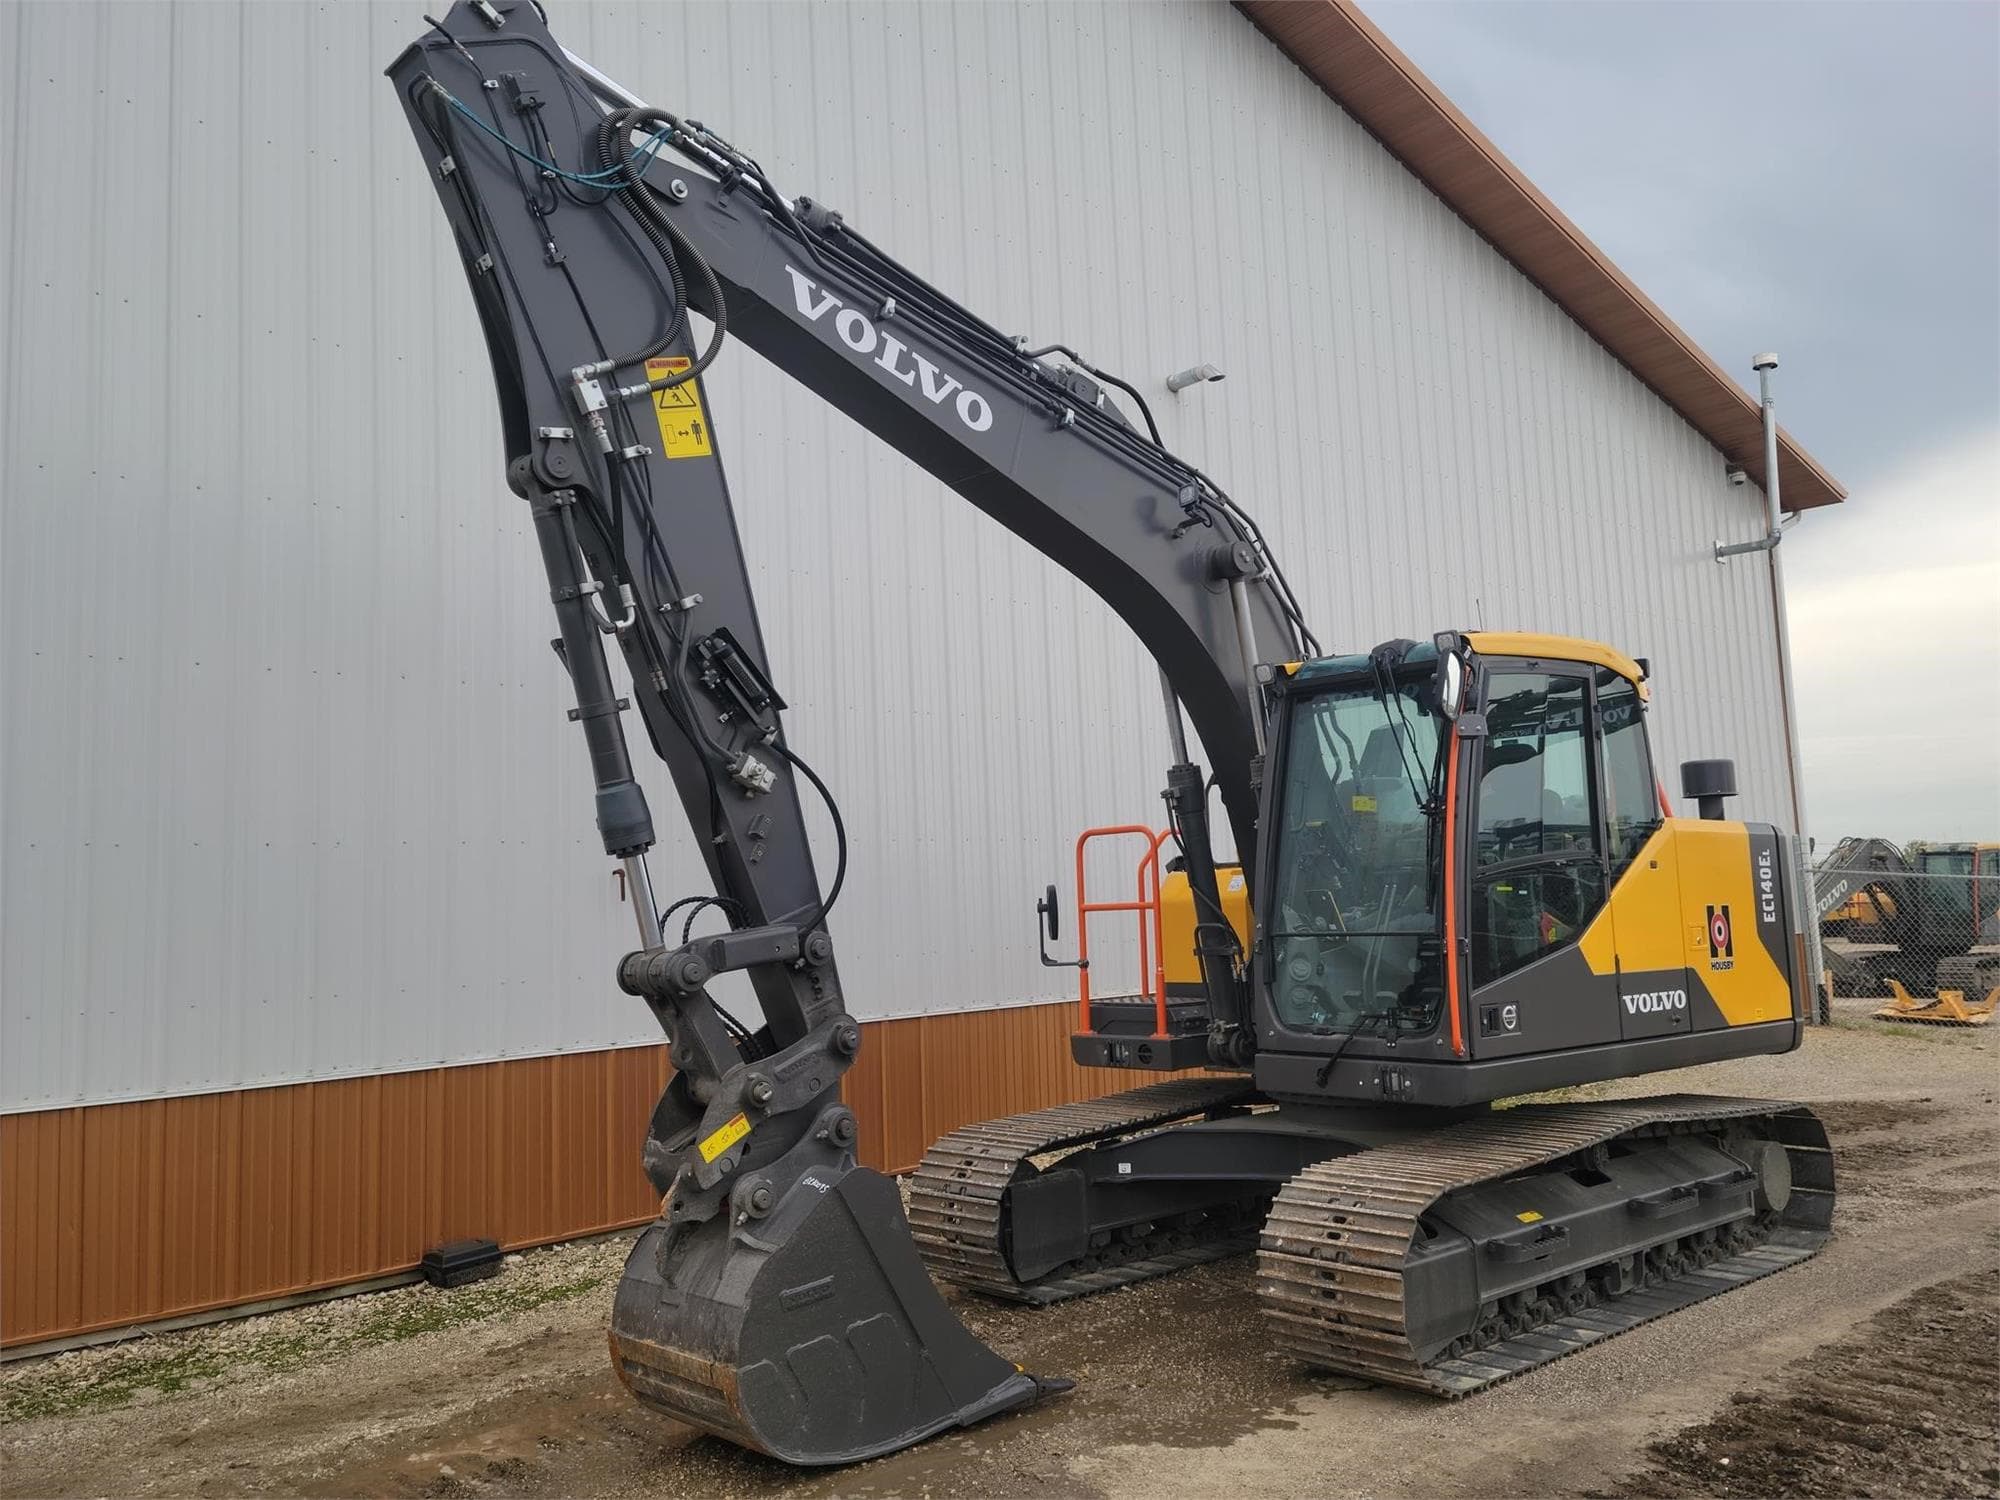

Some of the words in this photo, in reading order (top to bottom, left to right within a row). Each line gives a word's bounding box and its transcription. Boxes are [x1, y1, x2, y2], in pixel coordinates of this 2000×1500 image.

[785, 264, 993, 432] VOLVO
[1759, 849, 1776, 922] EC140EL
[1711, 960, 1734, 971] HOUSBY
[1622, 989, 1687, 1015] VOLVO
